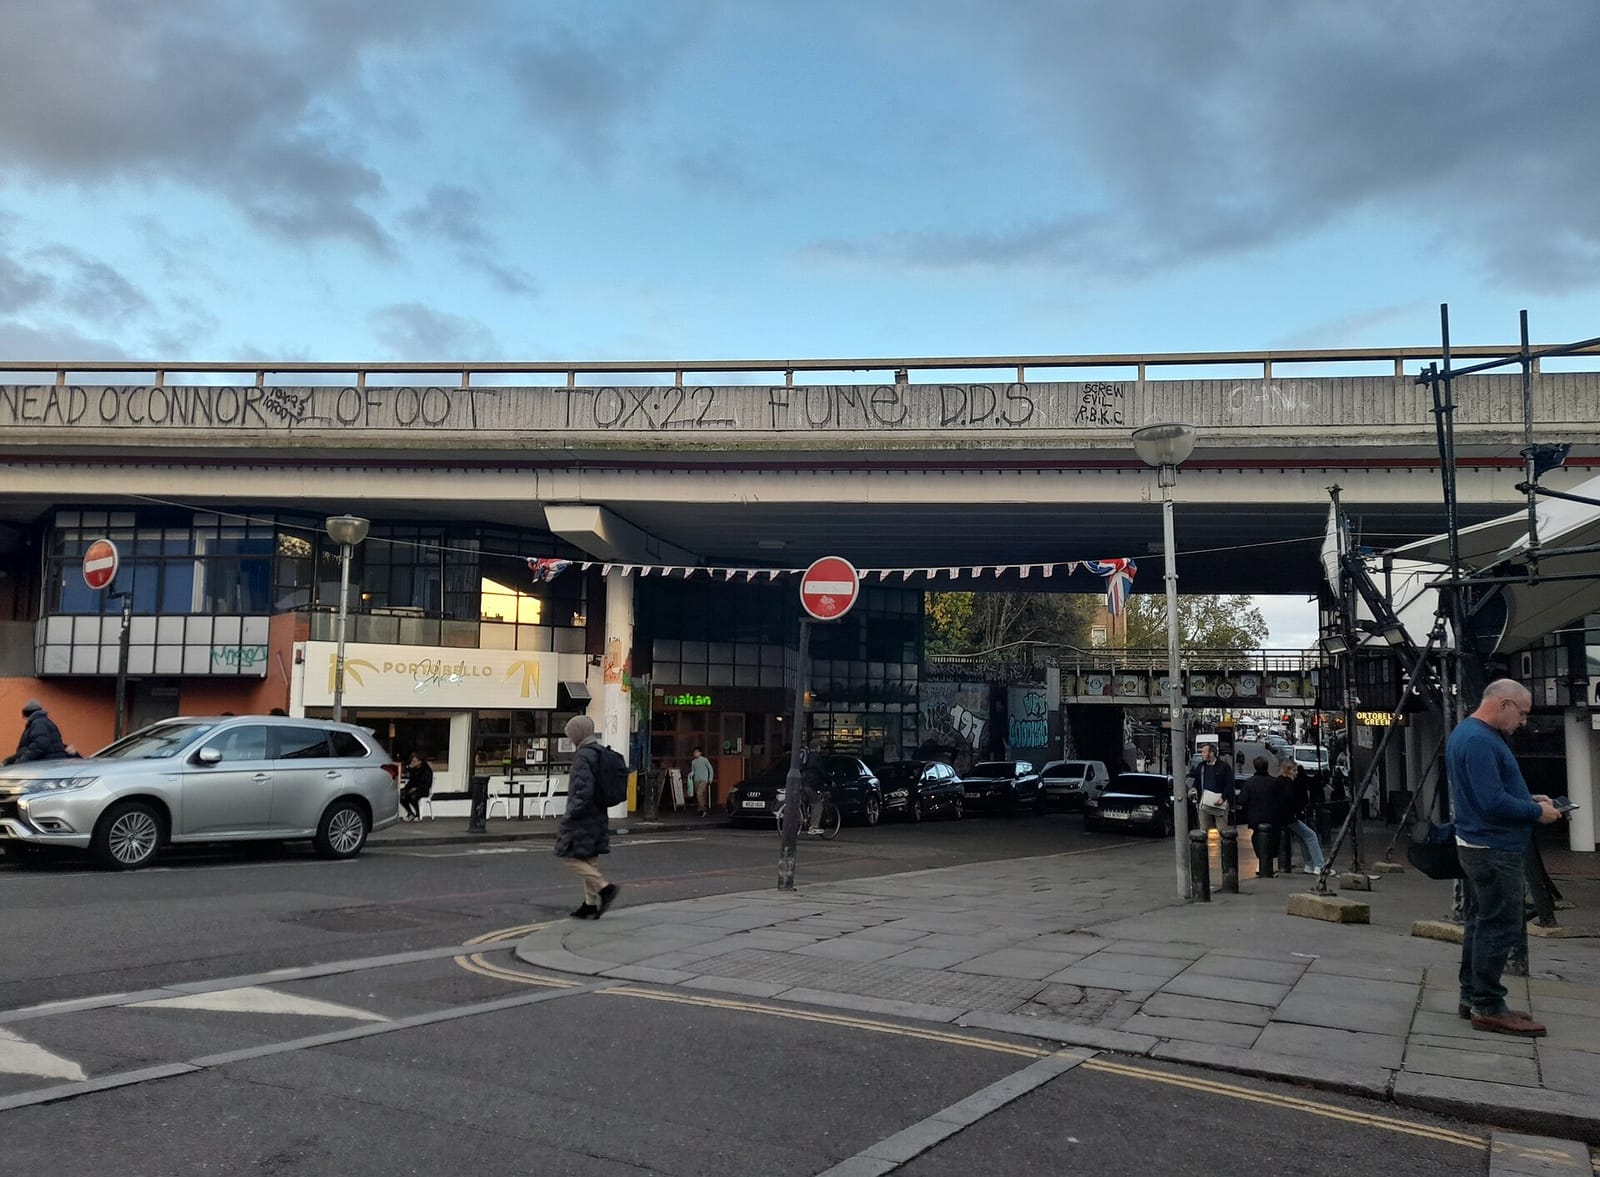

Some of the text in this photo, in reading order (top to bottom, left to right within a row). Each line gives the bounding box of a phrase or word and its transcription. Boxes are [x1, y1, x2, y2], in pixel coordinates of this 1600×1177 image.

[1083, 383, 1123, 398] SCREW
[0, 386, 267, 427] NEAD O'CONNOR
[1083, 394, 1112, 407] EVIL
[383, 661, 493, 677] PORTOBELLO
[664, 693, 711, 705] makan
